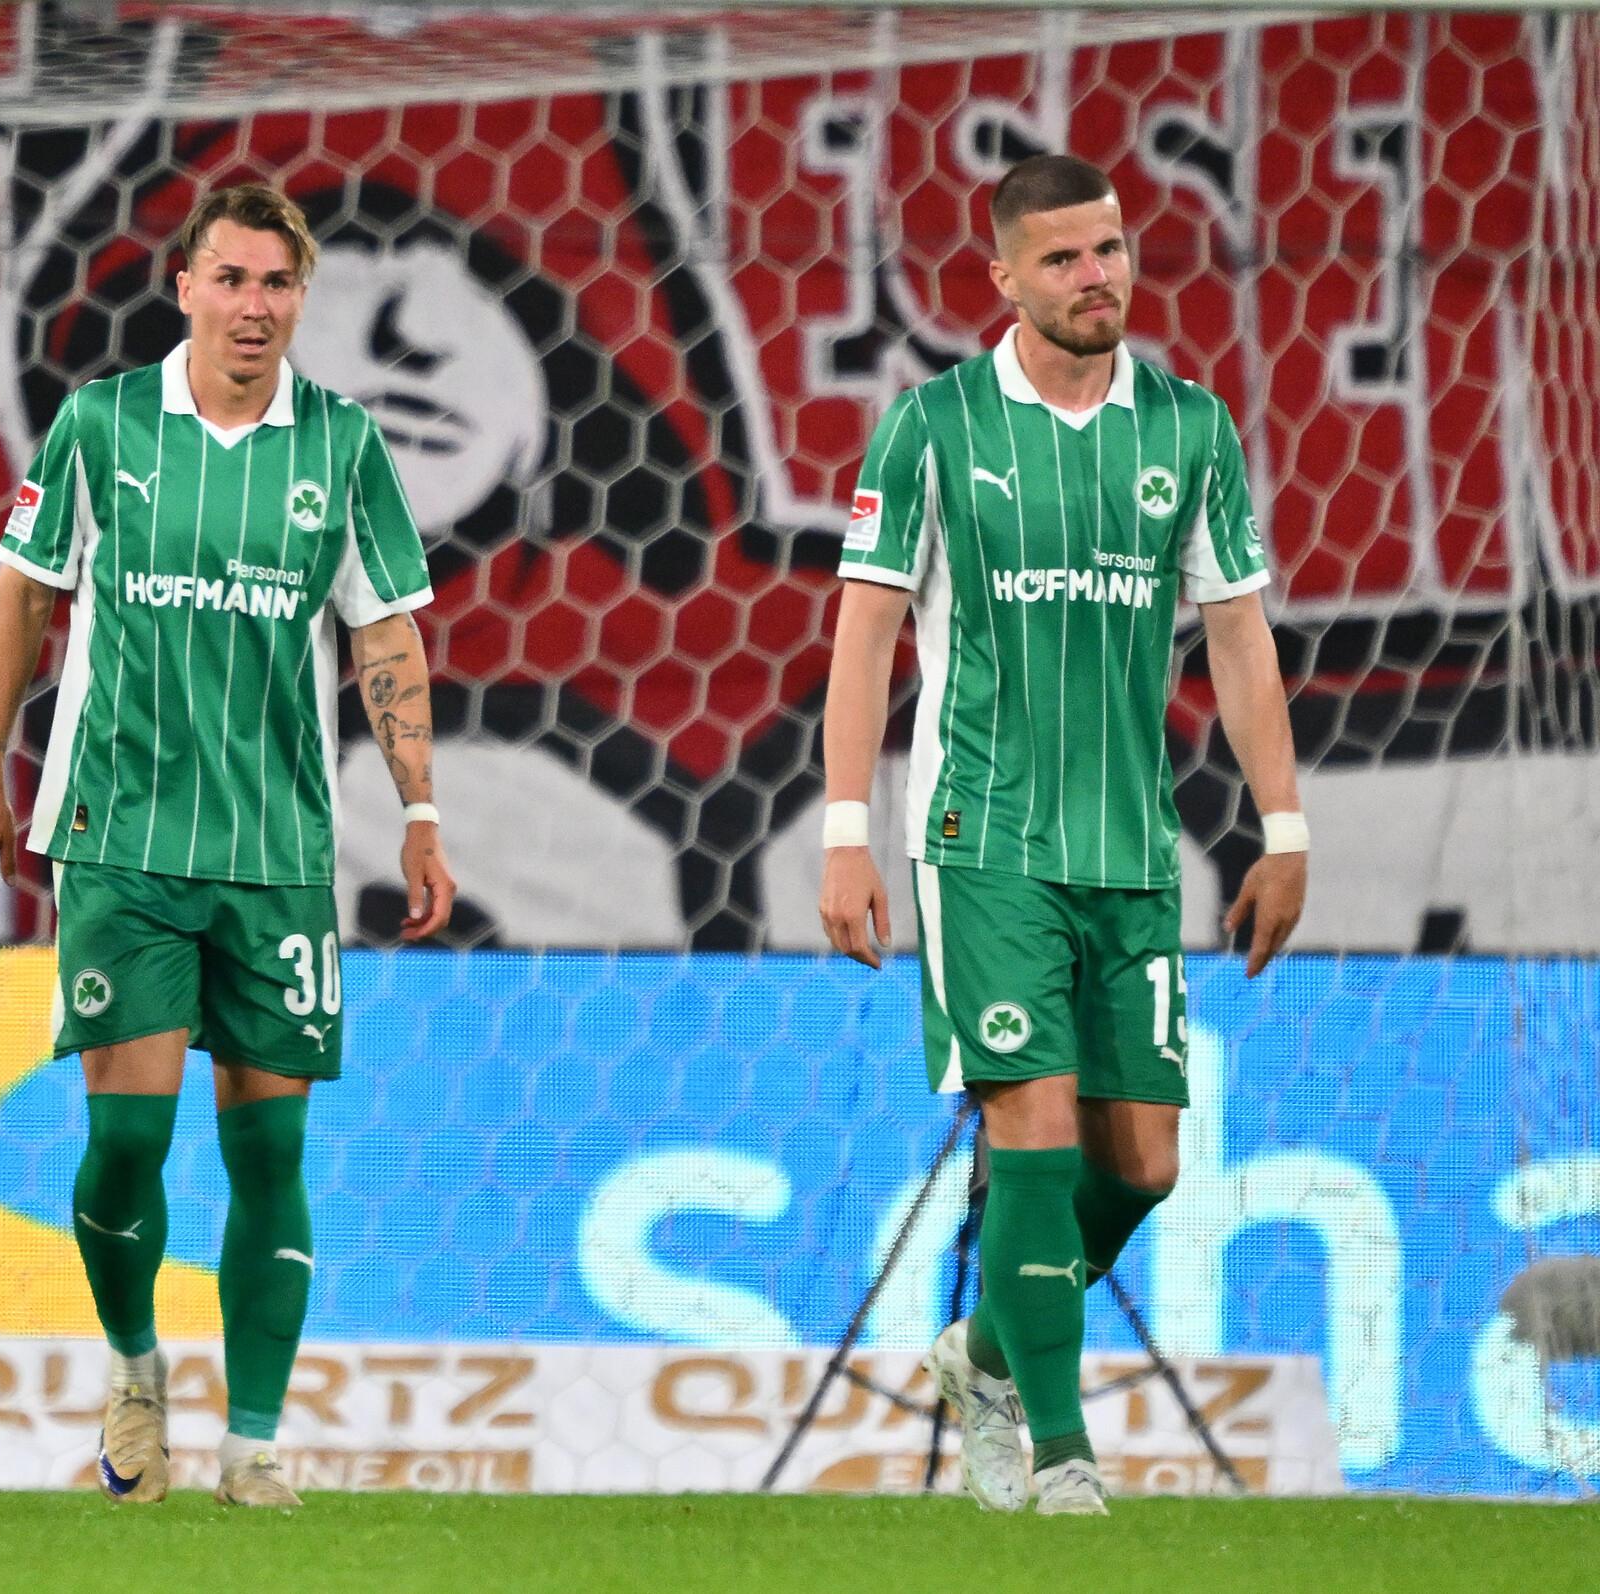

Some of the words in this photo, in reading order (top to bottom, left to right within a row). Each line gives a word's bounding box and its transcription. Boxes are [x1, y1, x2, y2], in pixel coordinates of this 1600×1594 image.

[226, 558, 305, 586] Personal
[278, 930, 342, 1017] 30
[650, 1356, 1275, 1434] QUATZ
[405, 1447, 502, 1494] OIL
